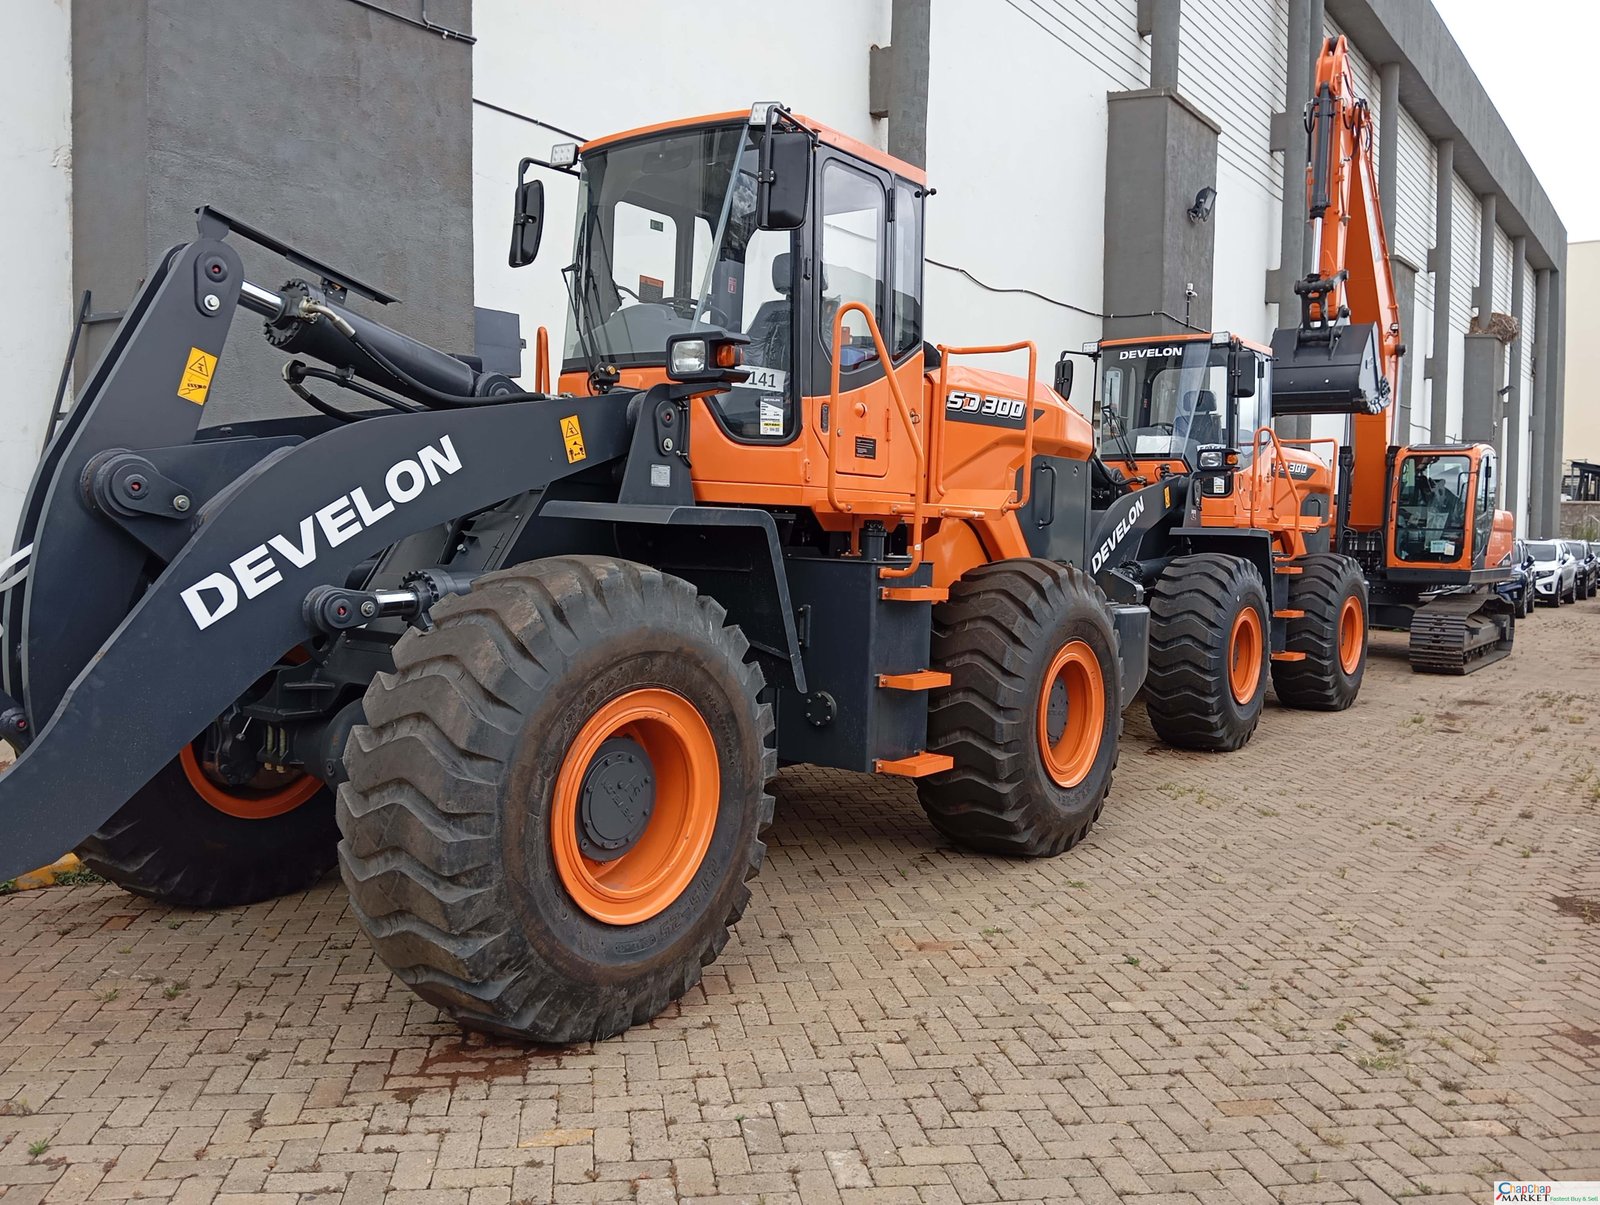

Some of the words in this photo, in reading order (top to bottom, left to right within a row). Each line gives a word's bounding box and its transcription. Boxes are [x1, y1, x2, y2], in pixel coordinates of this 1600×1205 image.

[1119, 347, 1183, 360] DEVELON
[946, 390, 982, 414] SD
[981, 395, 1026, 420] 300
[180, 434, 463, 631] DEVELON
[1091, 495, 1145, 575] DEVELON
